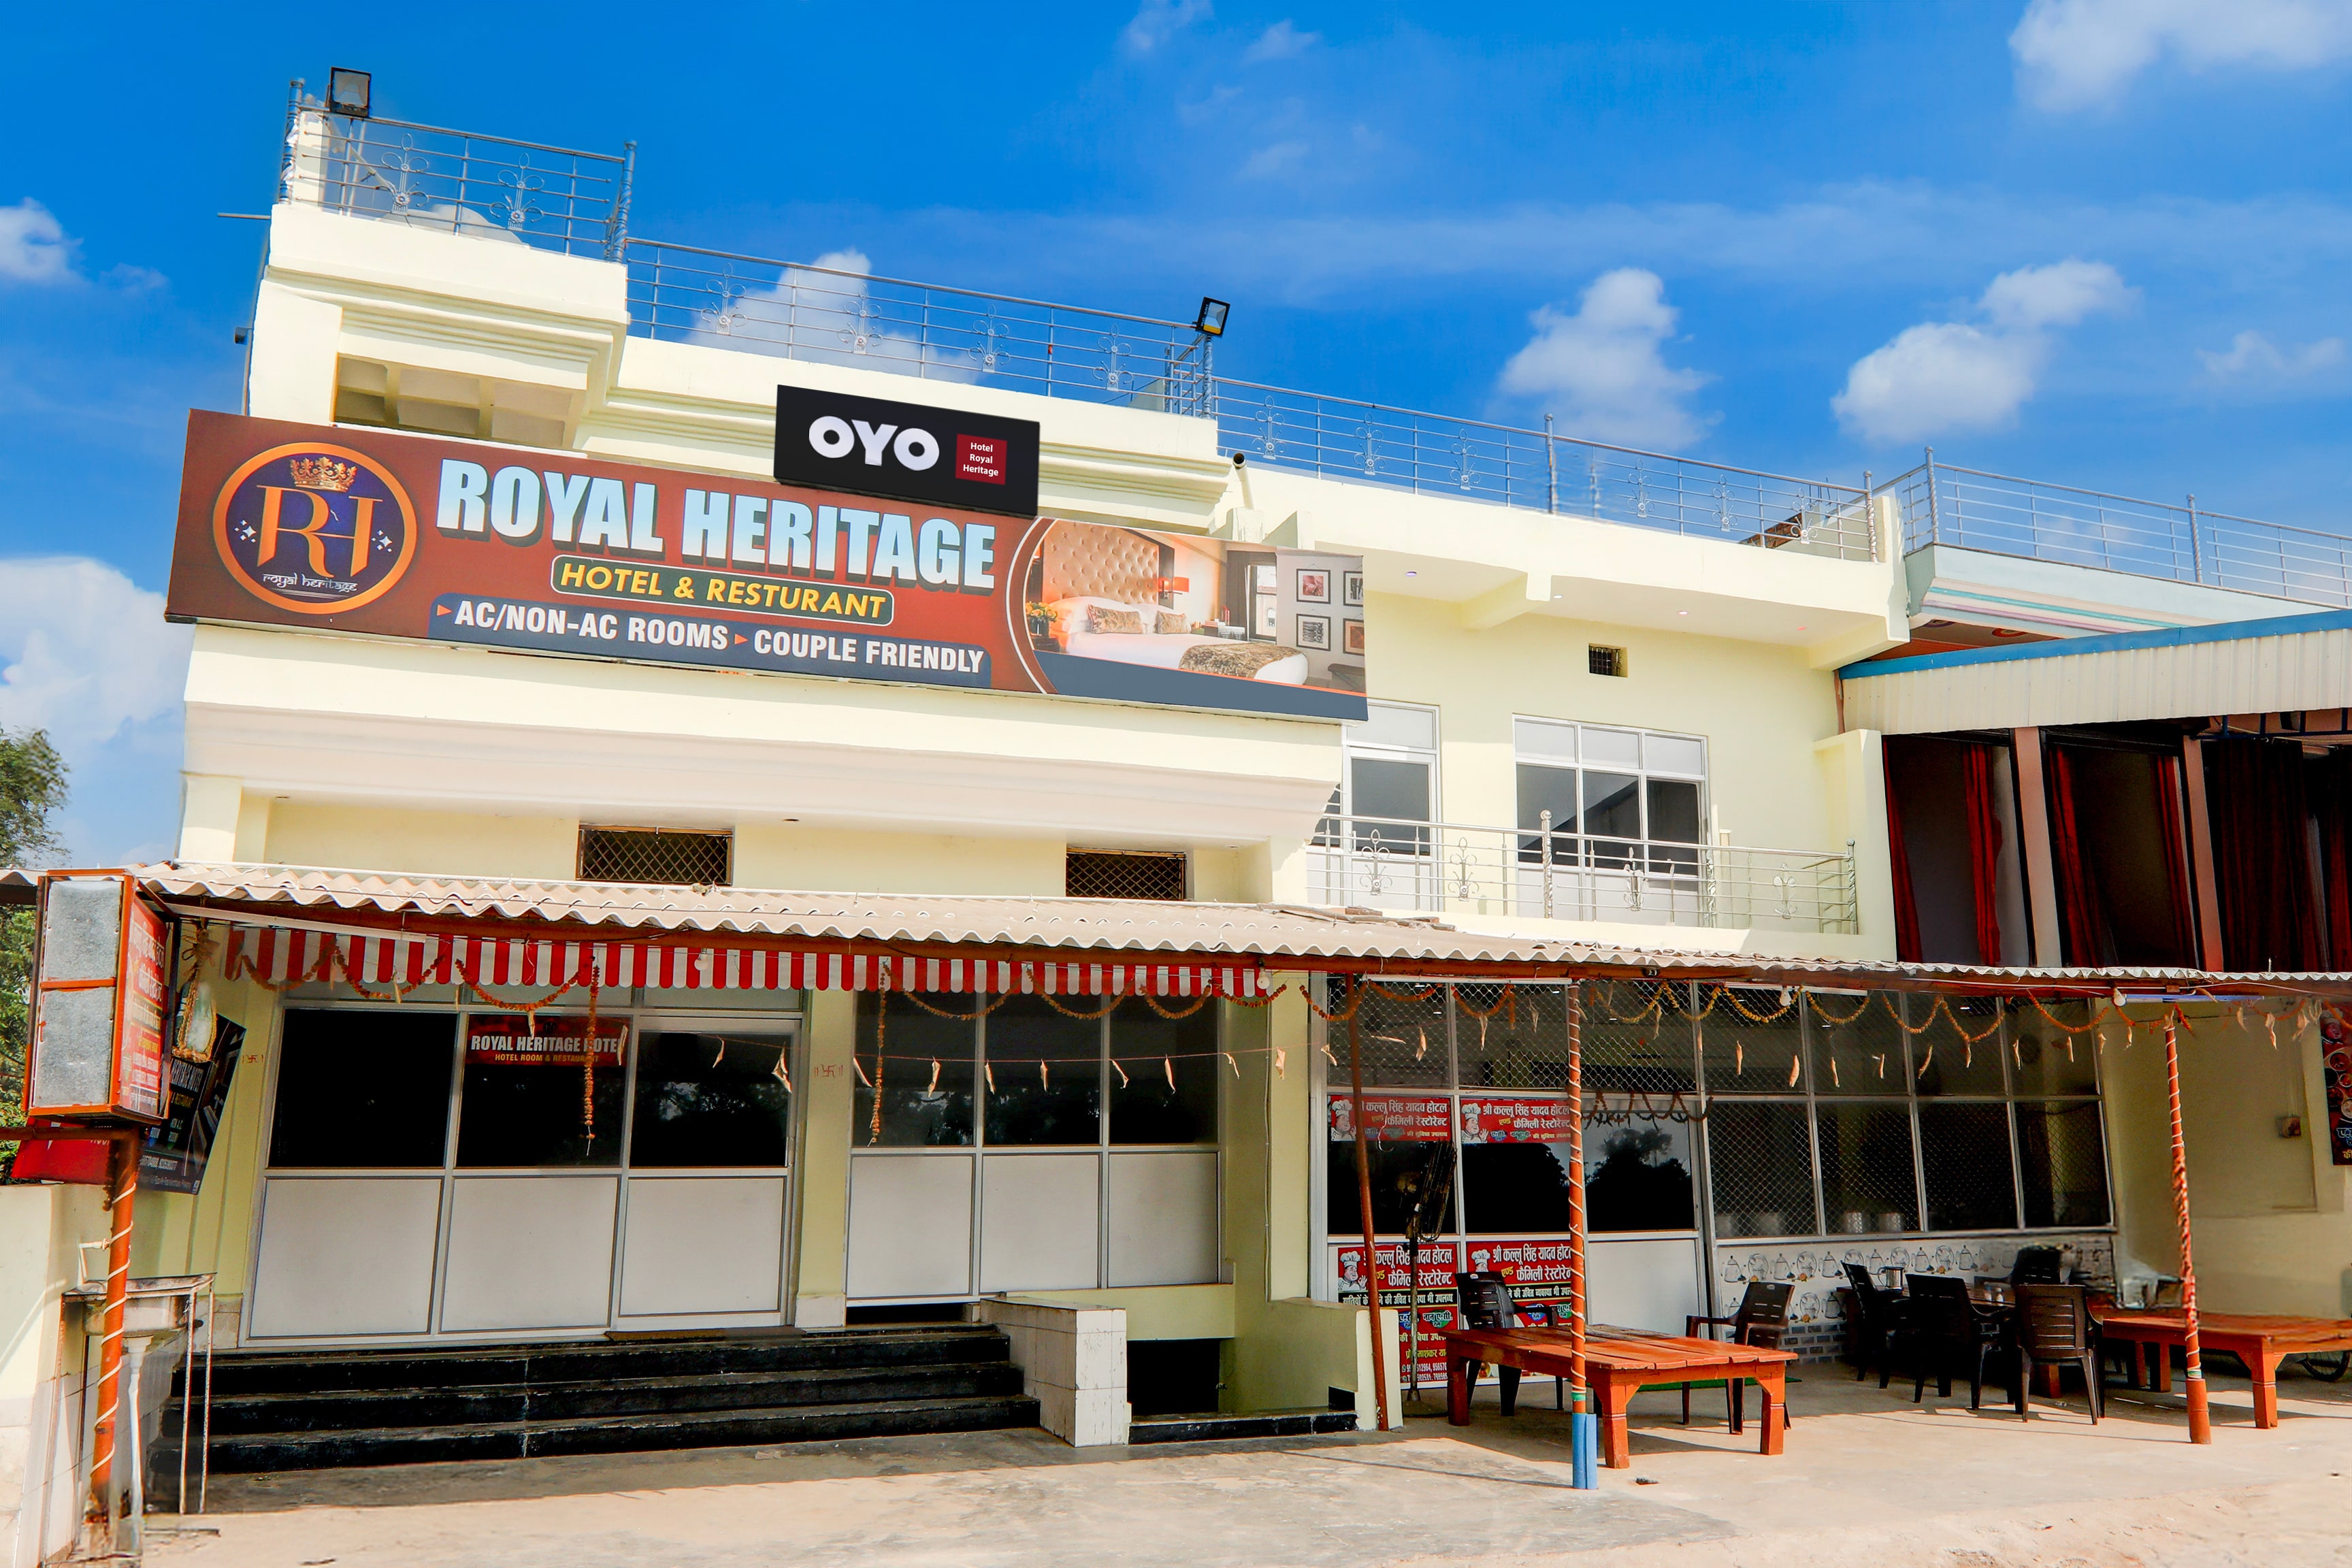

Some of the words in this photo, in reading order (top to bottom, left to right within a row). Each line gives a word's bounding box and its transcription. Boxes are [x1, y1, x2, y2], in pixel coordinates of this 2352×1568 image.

[808, 415, 940, 471] OYO
[970, 442, 993, 453] Hotel
[970, 453, 993, 464] Royal
[963, 464, 999, 477] Heritage
[436, 458, 664, 553] ROYAL
[682, 488, 996, 590] HERITAGE
[263, 572, 297, 588] royal
[301, 573, 358, 593] heritage
[561, 562, 662, 598] HOTEL
[673, 576, 695, 599] &
[706, 578, 886, 619] RESTURANT
[455, 600, 617, 640] AC/NON-AC
[628, 619, 728, 650] ROOMS
[754, 630, 857, 662] COUPLE
[866, 641, 984, 674] FRIENDLY
[471, 1035, 513, 1051] ROYAL
[517, 1036, 581, 1052] HERITAGE
[583, 1038, 621, 1053] OTE
[1405, 1102, 1425, 1113] यादव
[1426, 1100, 1448, 1113] होटल
[1483, 1102, 1492, 1115] श्री
[1515, 1102, 1529, 1116] सिंह
[1531, 1105, 1549, 1115] यादव
[1432, 1245, 1452, 1264] होटल
[1492, 1245, 1502, 1263] श्री
[1523, 1243, 1537, 1262] सिंह
[1538, 1247, 1556, 1261] यादव
